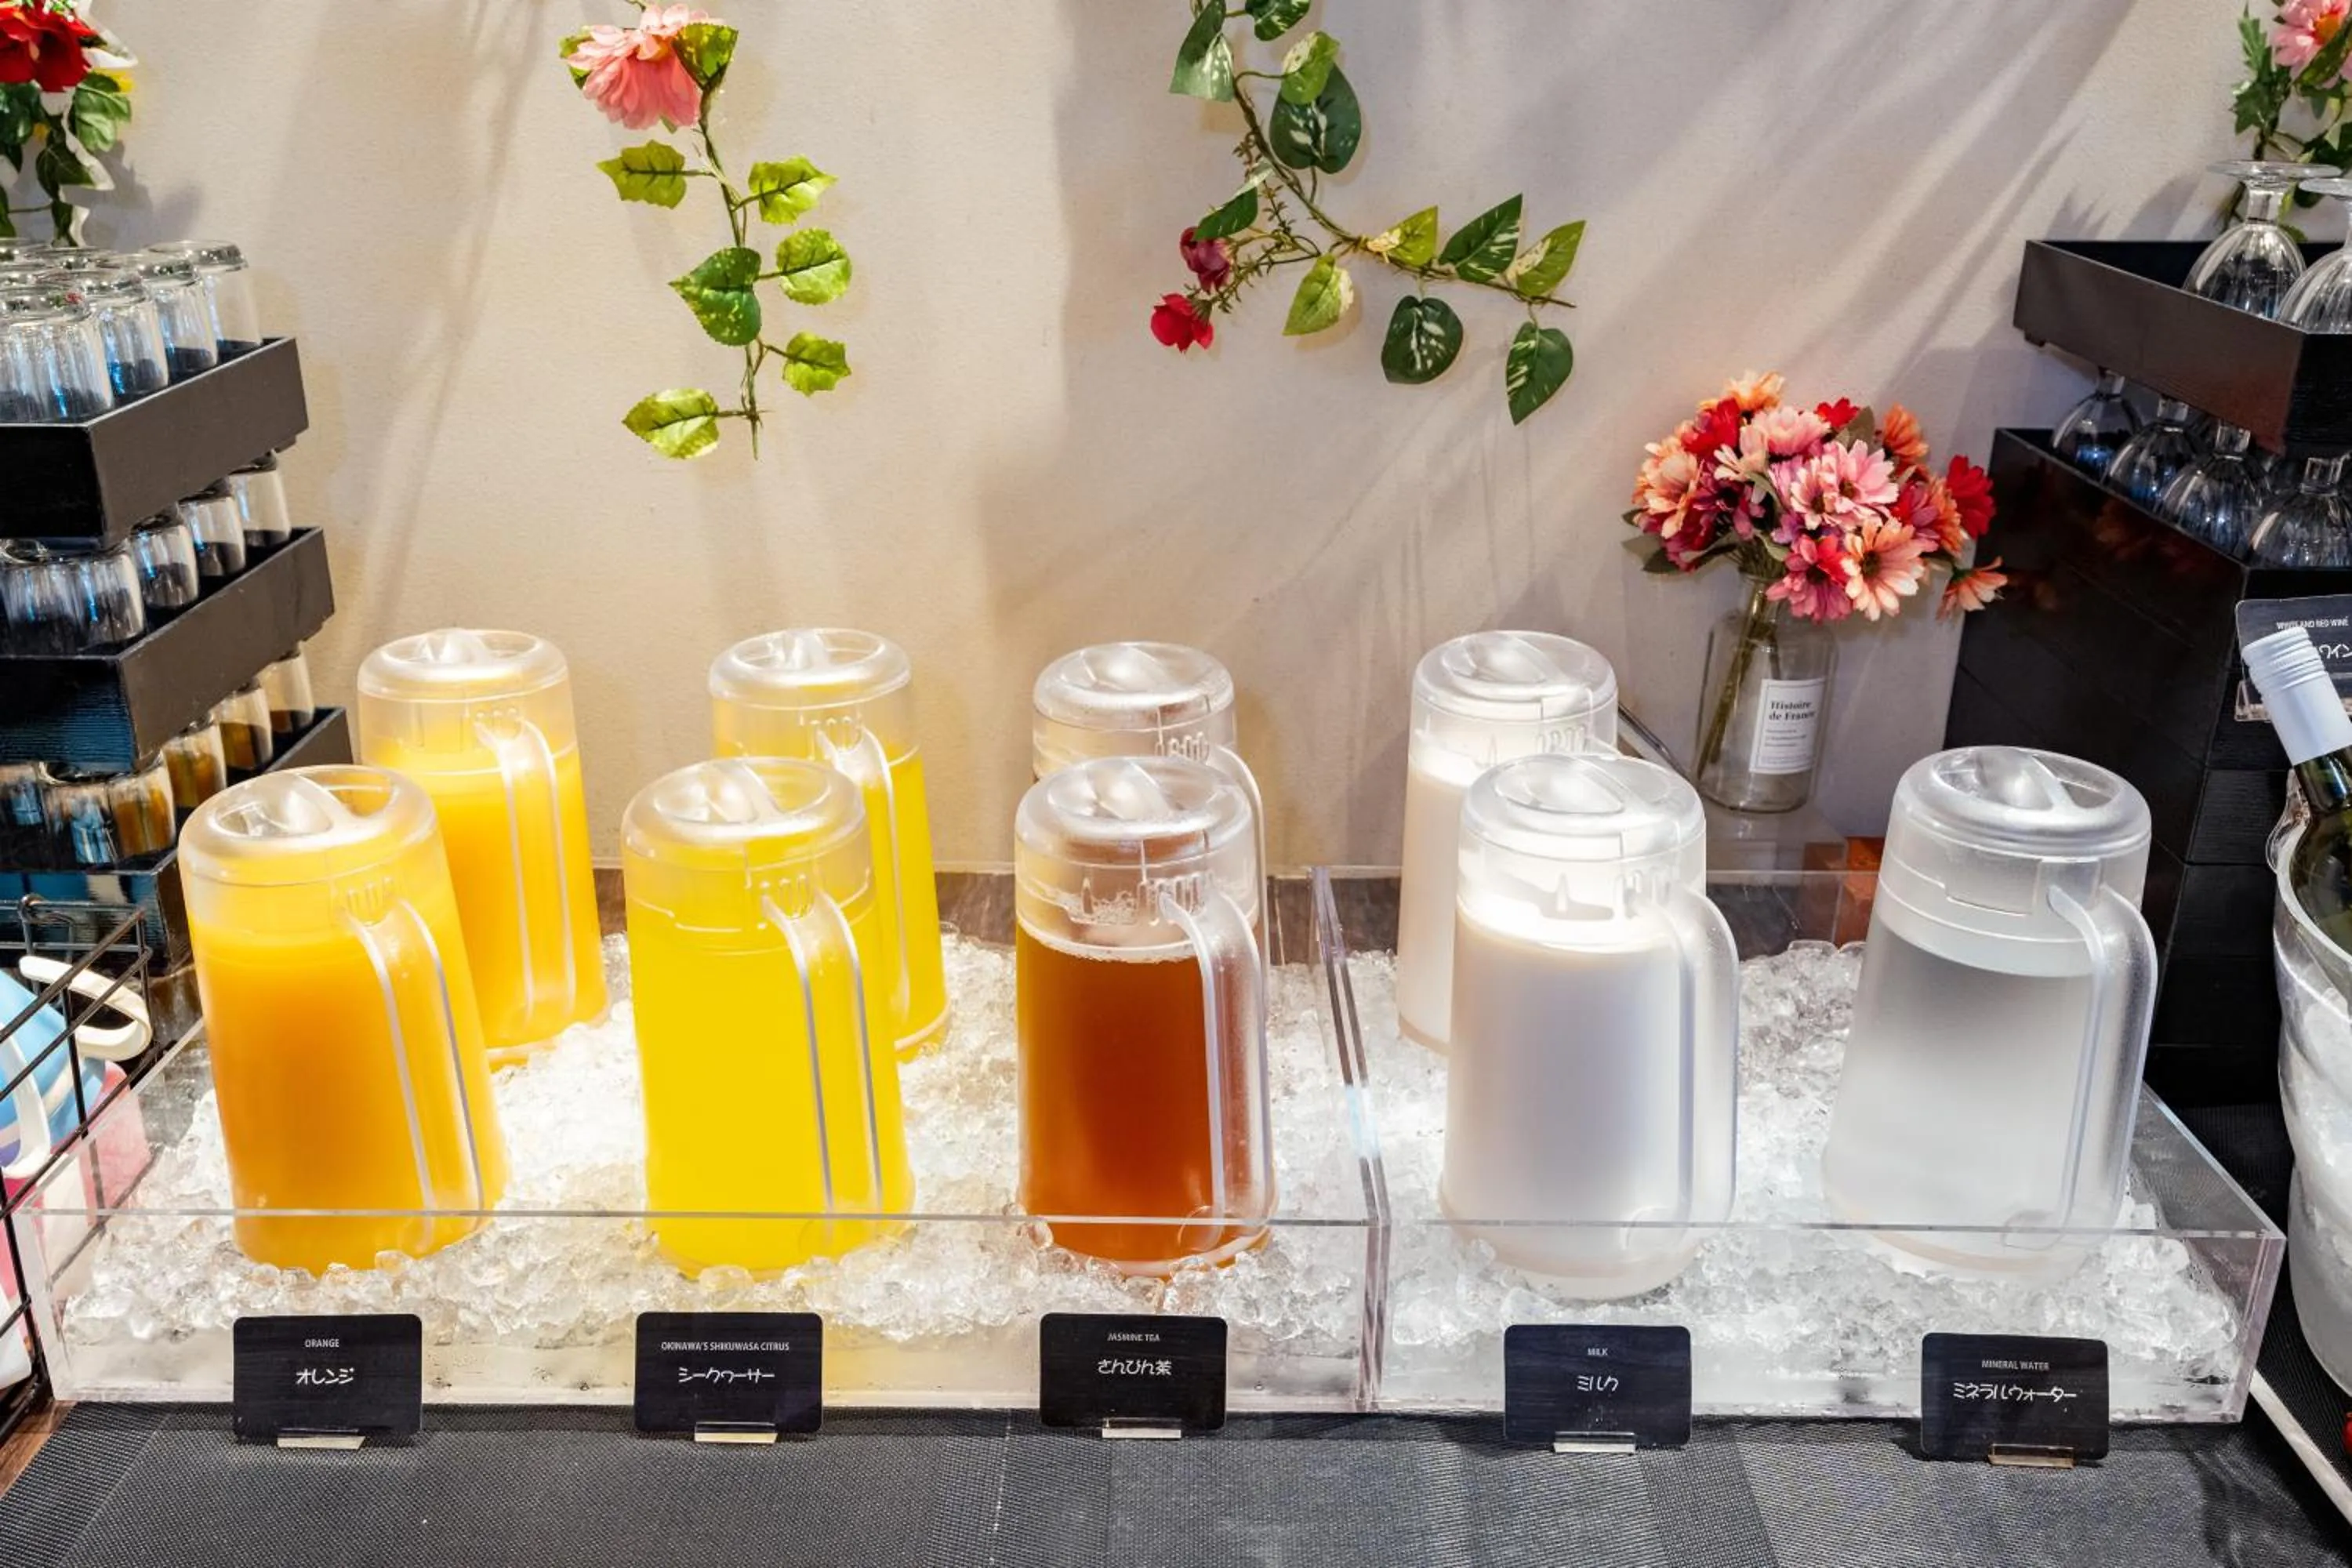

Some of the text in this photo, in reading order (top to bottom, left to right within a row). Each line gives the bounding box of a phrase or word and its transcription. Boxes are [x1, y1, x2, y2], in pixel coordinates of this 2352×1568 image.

[2330, 618, 2349, 627] WINE
[1769, 711, 1782, 720] de
[1107, 1333, 1144, 1341] JASMINE
[304, 1338, 339, 1348] ORANGE
[710, 1341, 760, 1351] SHIKUWASA
[760, 1341, 789, 1351] CITRUS
[1588, 1348, 1608, 1356] MILK
[1981, 1359, 2050, 1371] MINERAL WATER
[296, 1367, 355, 1385] オレンジ
[1577, 1374, 1619, 1392] ミルク
[1953, 1382, 2077, 1403] ミネラルウォーター
